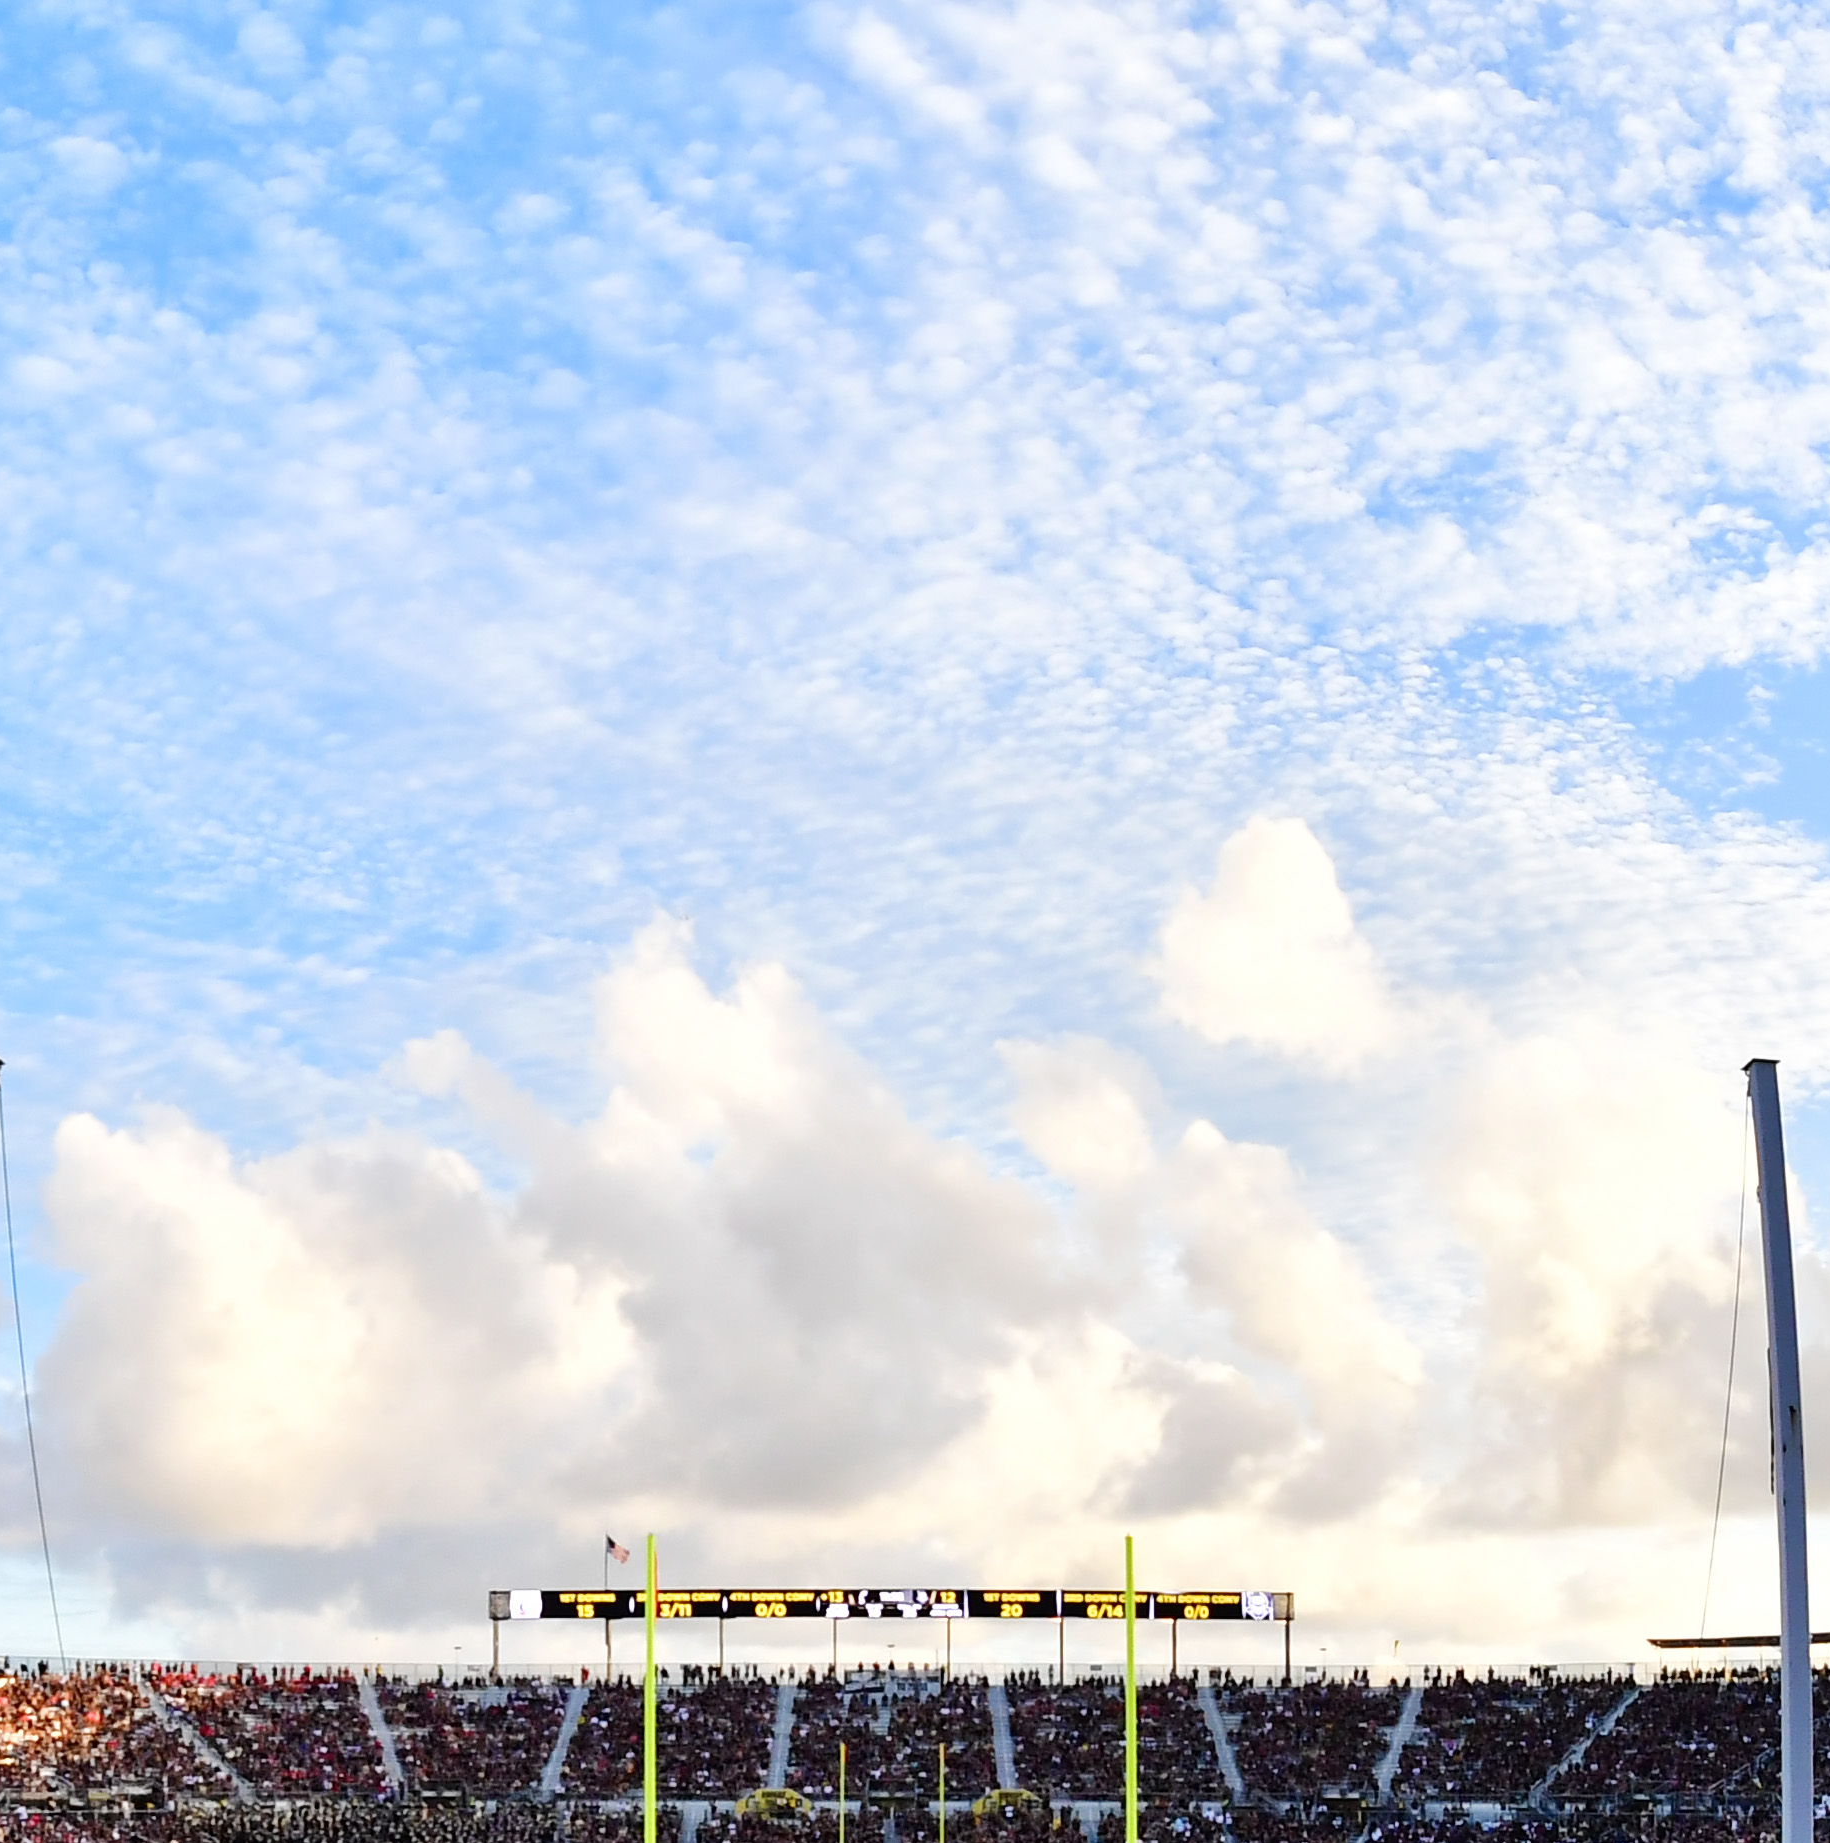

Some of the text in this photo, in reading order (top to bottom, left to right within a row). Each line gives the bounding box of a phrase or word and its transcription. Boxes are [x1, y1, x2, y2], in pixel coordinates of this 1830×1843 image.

[940, 1592, 956, 1603] 12
[577, 1604, 594, 1617] 15
[660, 1603, 692, 1617] 3/11
[755, 1603, 787, 1618] 0/0
[1000, 1604, 1023, 1617] 20
[1087, 1604, 1123, 1618] 6/14
[1184, 1604, 1210, 1619] 0/0
